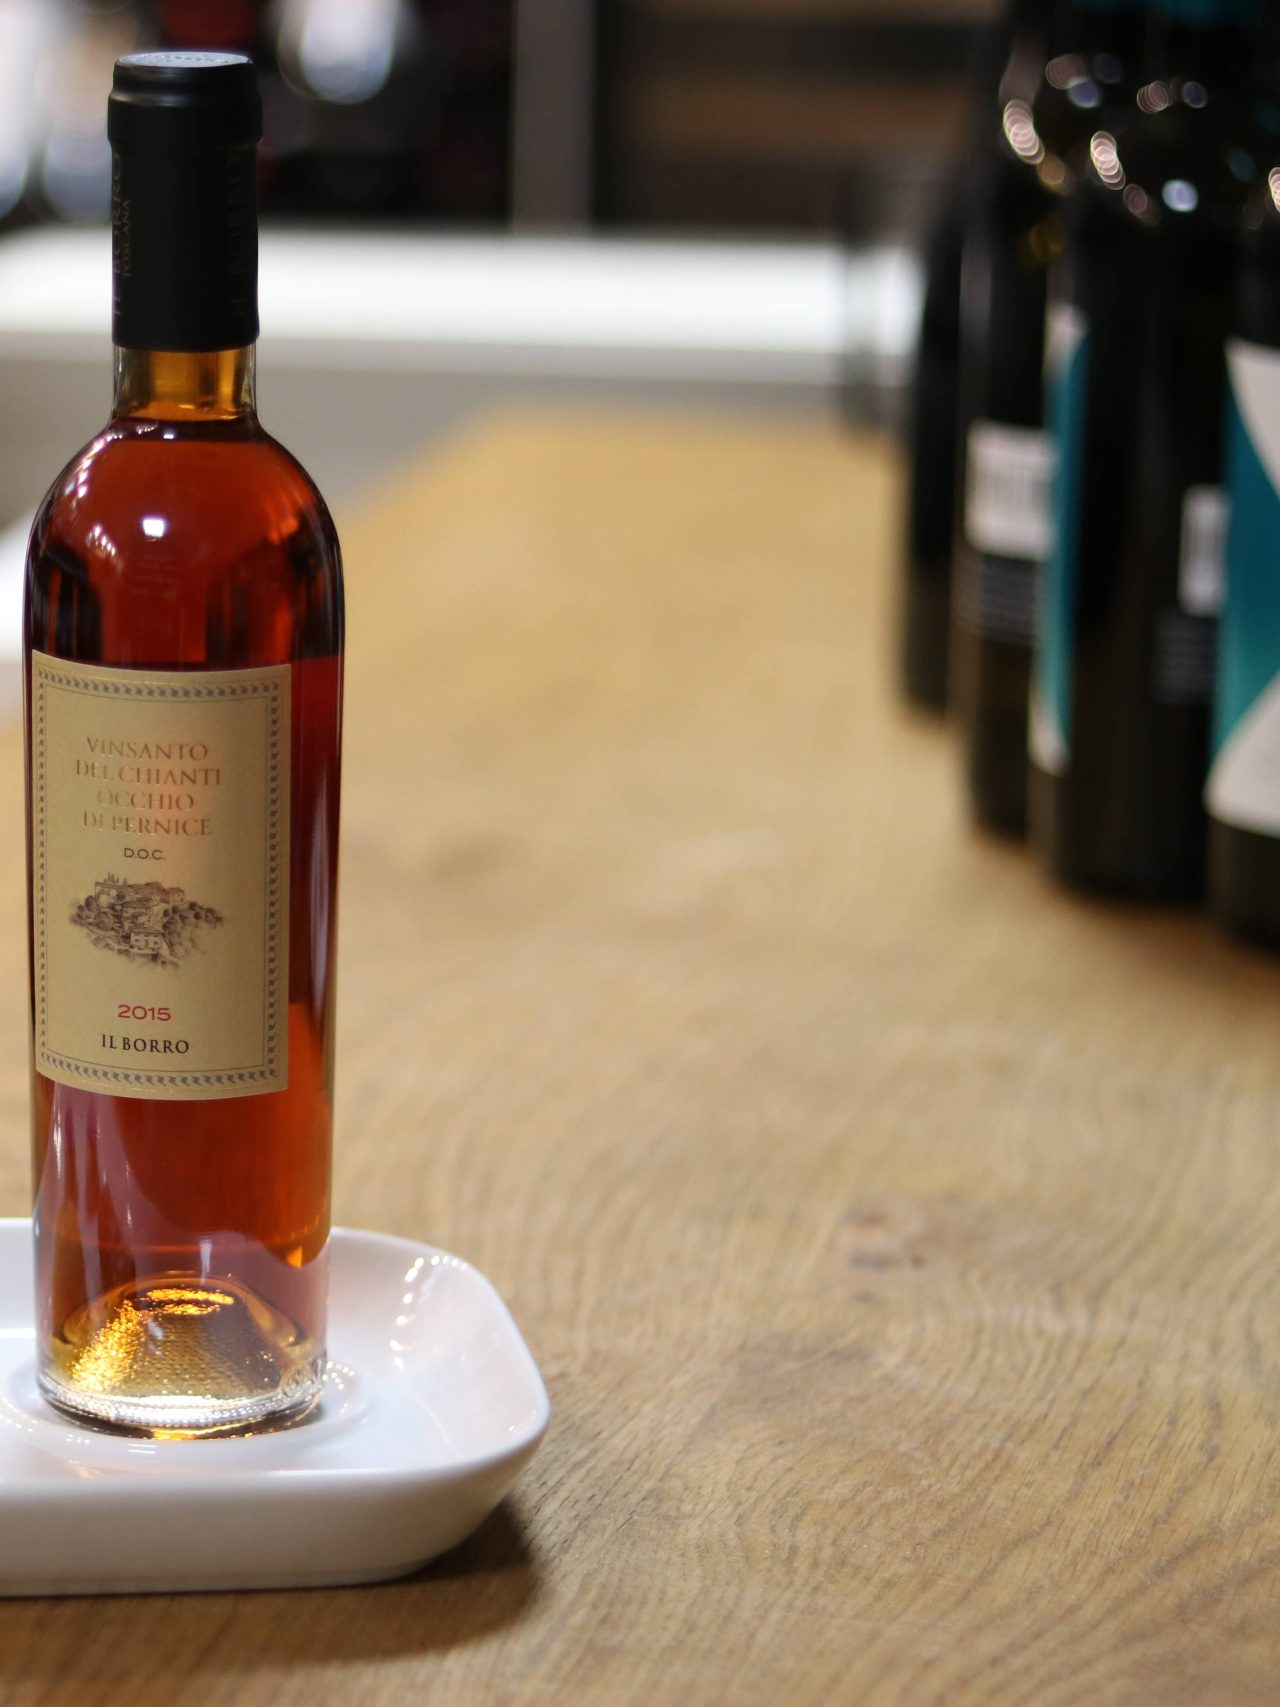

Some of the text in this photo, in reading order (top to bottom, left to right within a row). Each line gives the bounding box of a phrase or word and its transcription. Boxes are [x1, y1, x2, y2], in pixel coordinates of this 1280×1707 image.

[122, 199, 130, 278] TOSCANA
[87, 737, 209, 761] VINSANTO
[76, 759, 221, 786] DEL CHIANTI
[97, 788, 194, 811] OCCHIO
[83, 811, 213, 836] DI PERNICE
[124, 847, 166, 860] D.O.C.
[117, 1004, 171, 1021] 2015
[102, 1034, 189, 1054] IL BORRO
